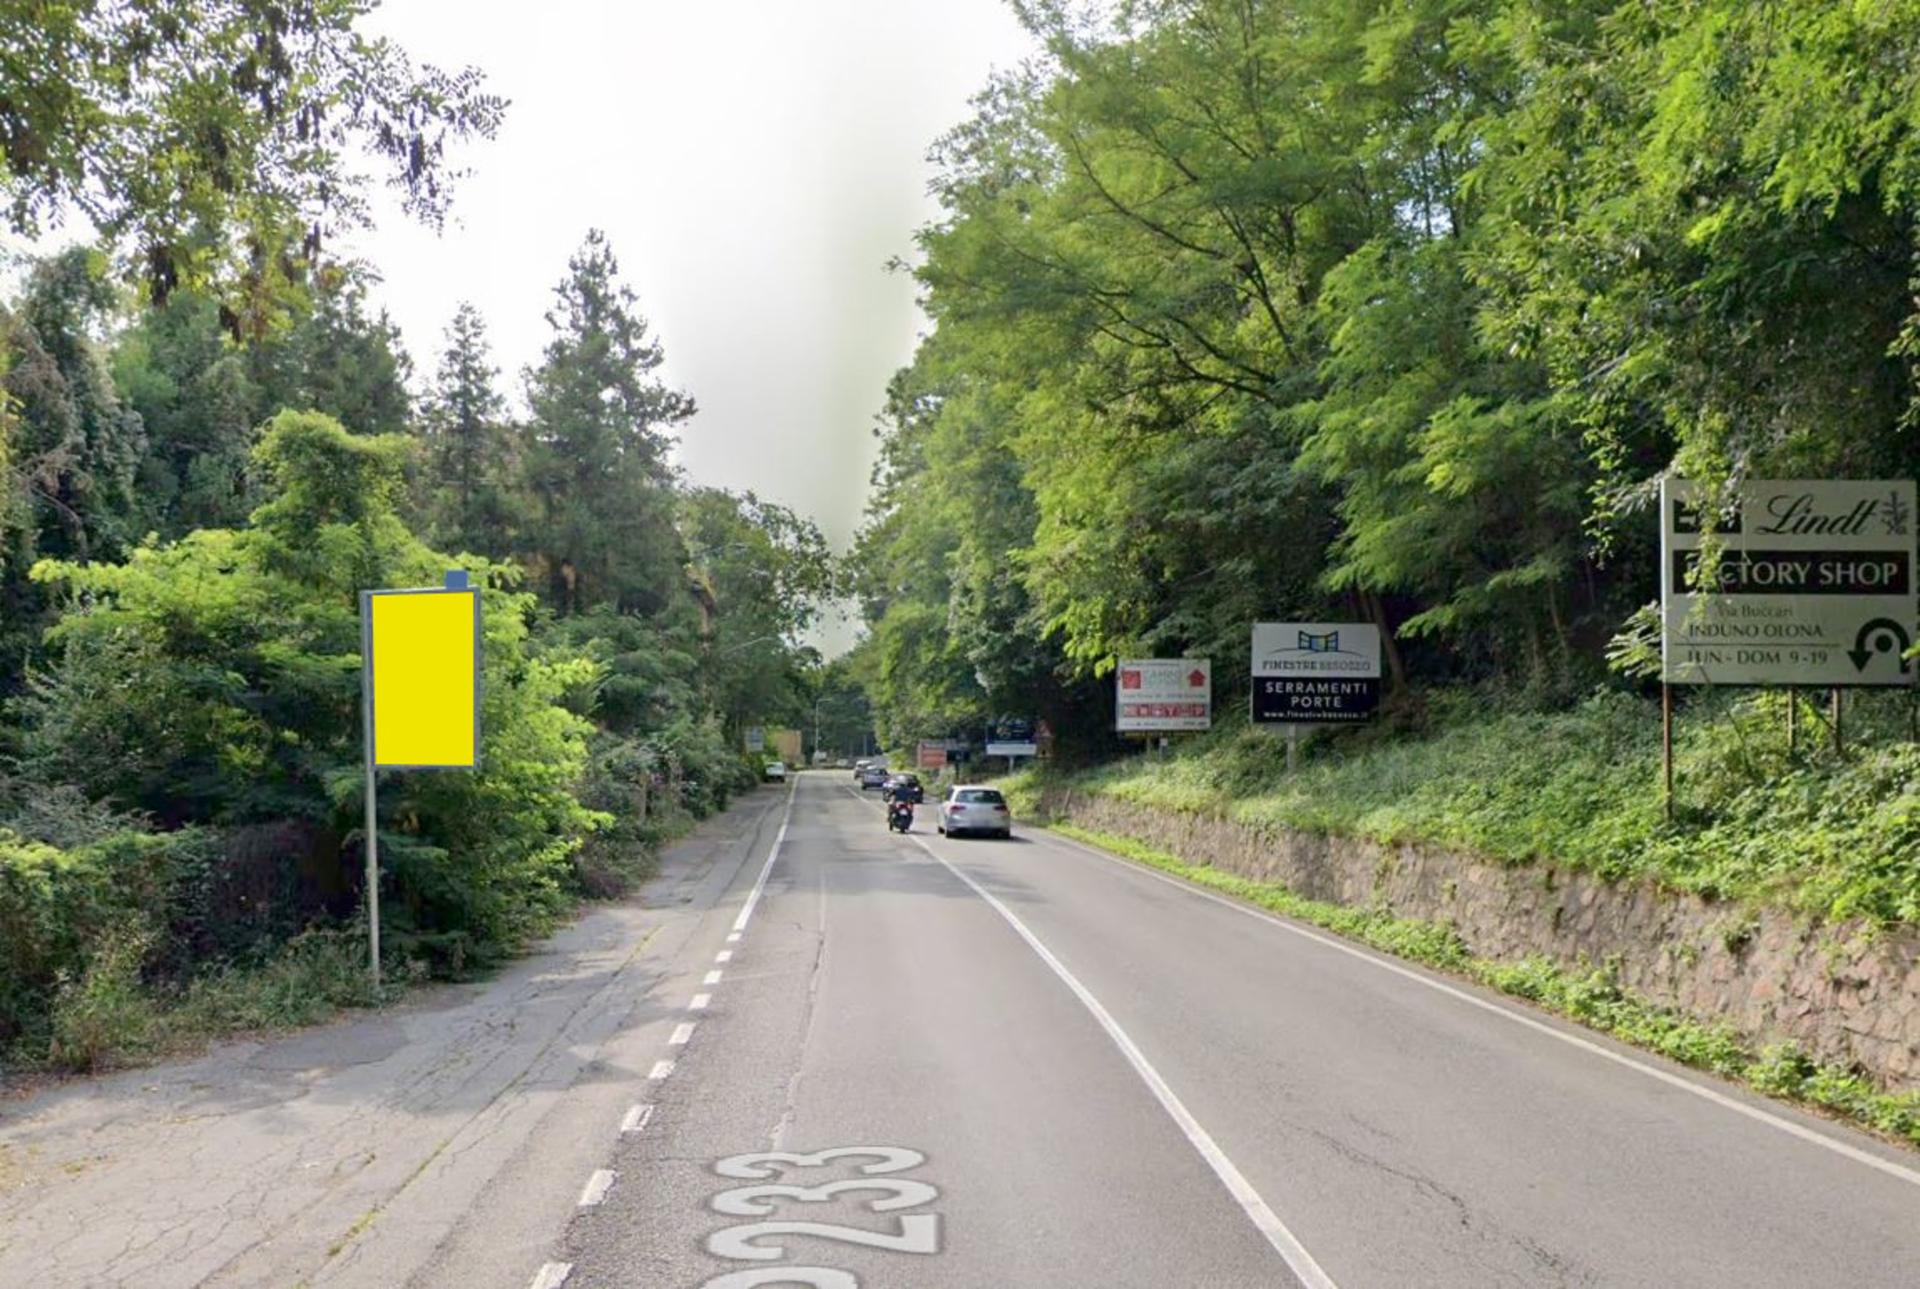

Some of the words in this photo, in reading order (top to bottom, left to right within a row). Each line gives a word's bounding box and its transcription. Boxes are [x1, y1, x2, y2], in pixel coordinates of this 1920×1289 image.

[1757, 494, 1878, 535] Lindt
[1819, 562, 1898, 586] SHOP
[1689, 624, 1760, 638] INDUNO
[1763, 624, 1823, 638] OLONA
[1737, 650, 1781, 664] DOM
[1265, 682, 1367, 695] SERRAMENTI
[1291, 696, 1342, 708] PORTE
